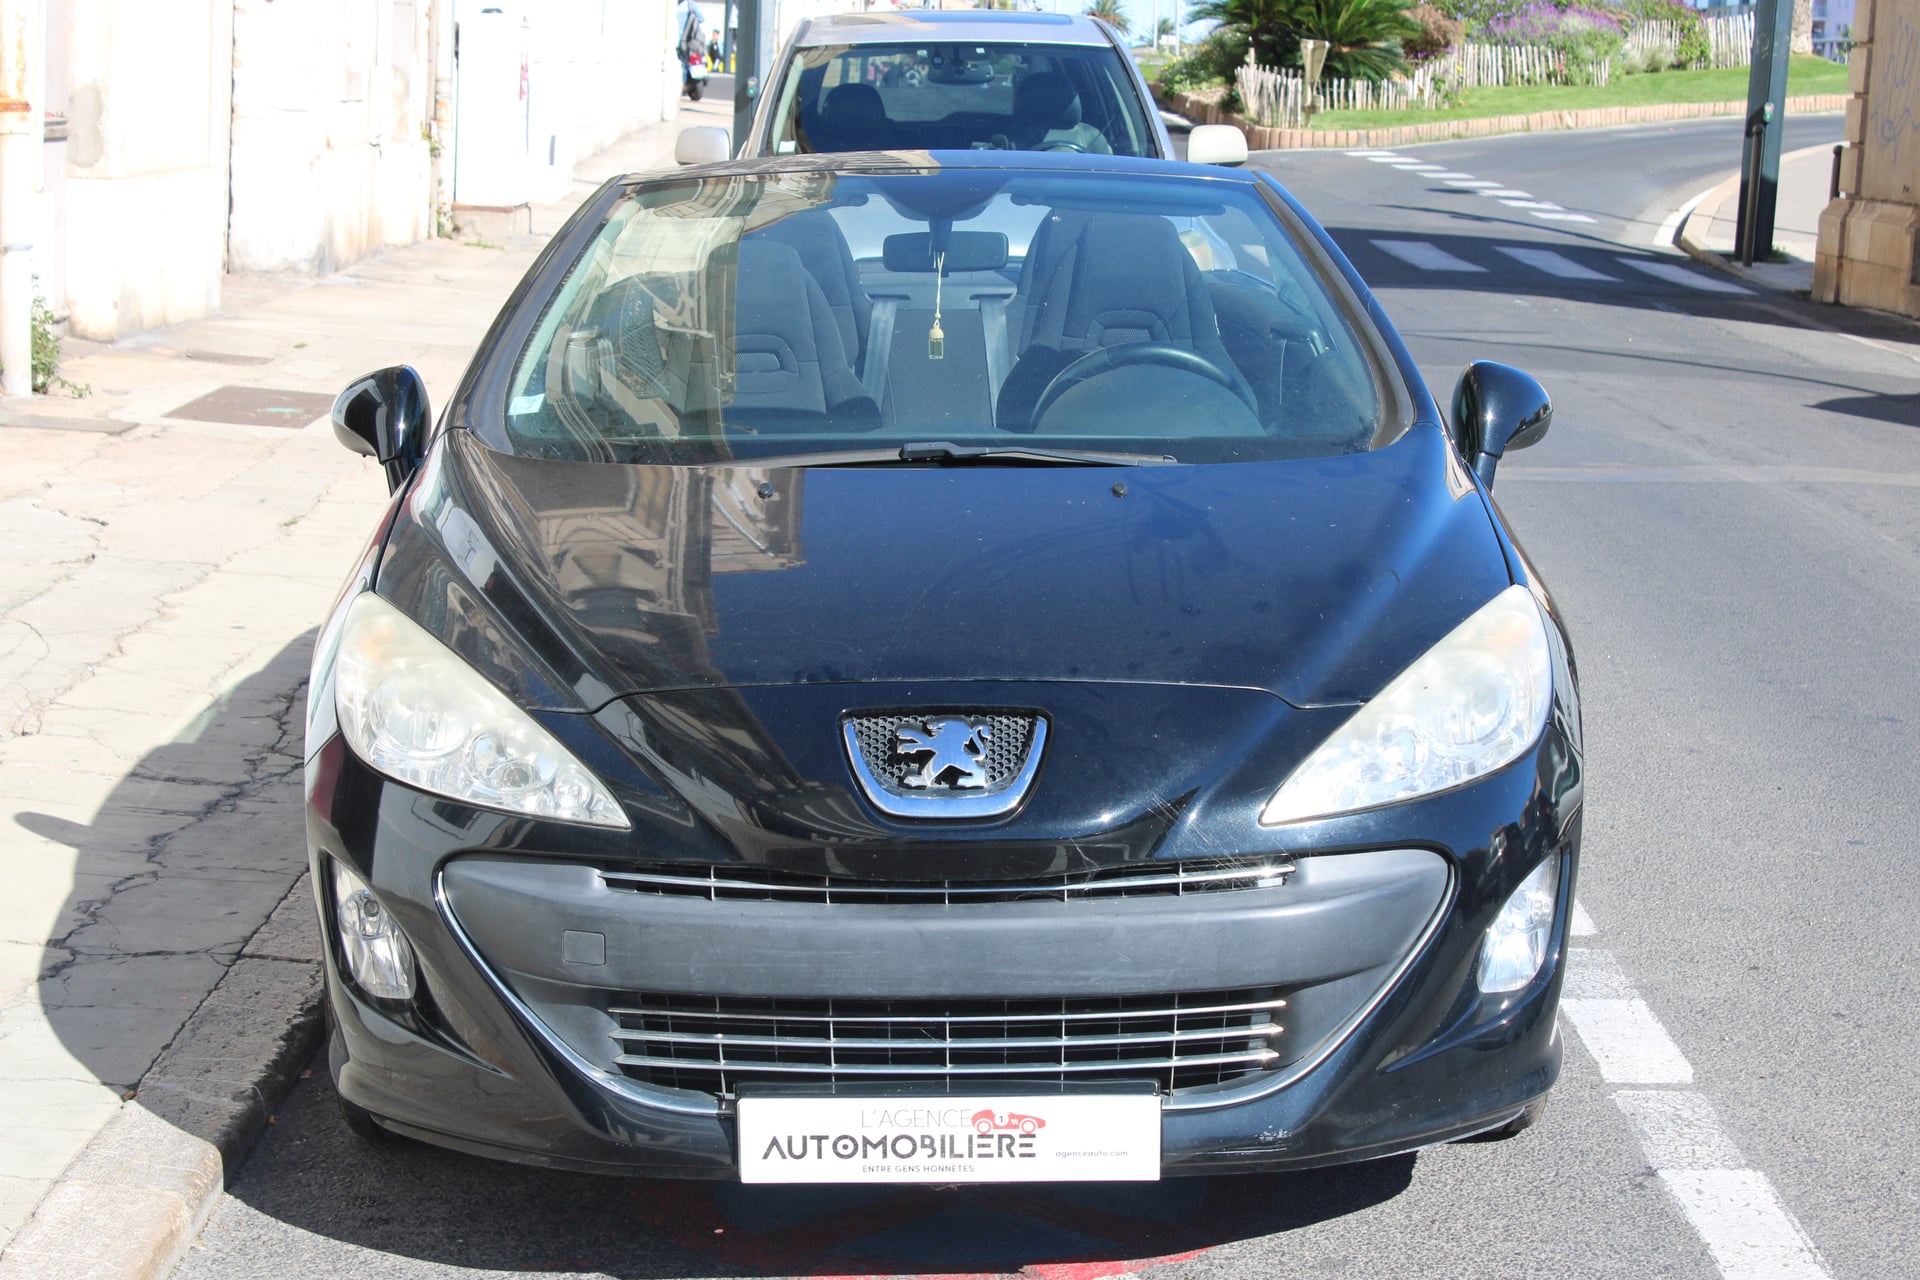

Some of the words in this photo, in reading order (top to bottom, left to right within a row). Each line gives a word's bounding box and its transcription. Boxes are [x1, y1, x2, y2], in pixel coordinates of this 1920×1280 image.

[861, 1108, 972, 1128] L'AGENCE
[1055, 1149, 1129, 1159] agenceautocom
[862, 1165, 893, 1173] ENTRE
[894, 1165, 921, 1173] GENS
